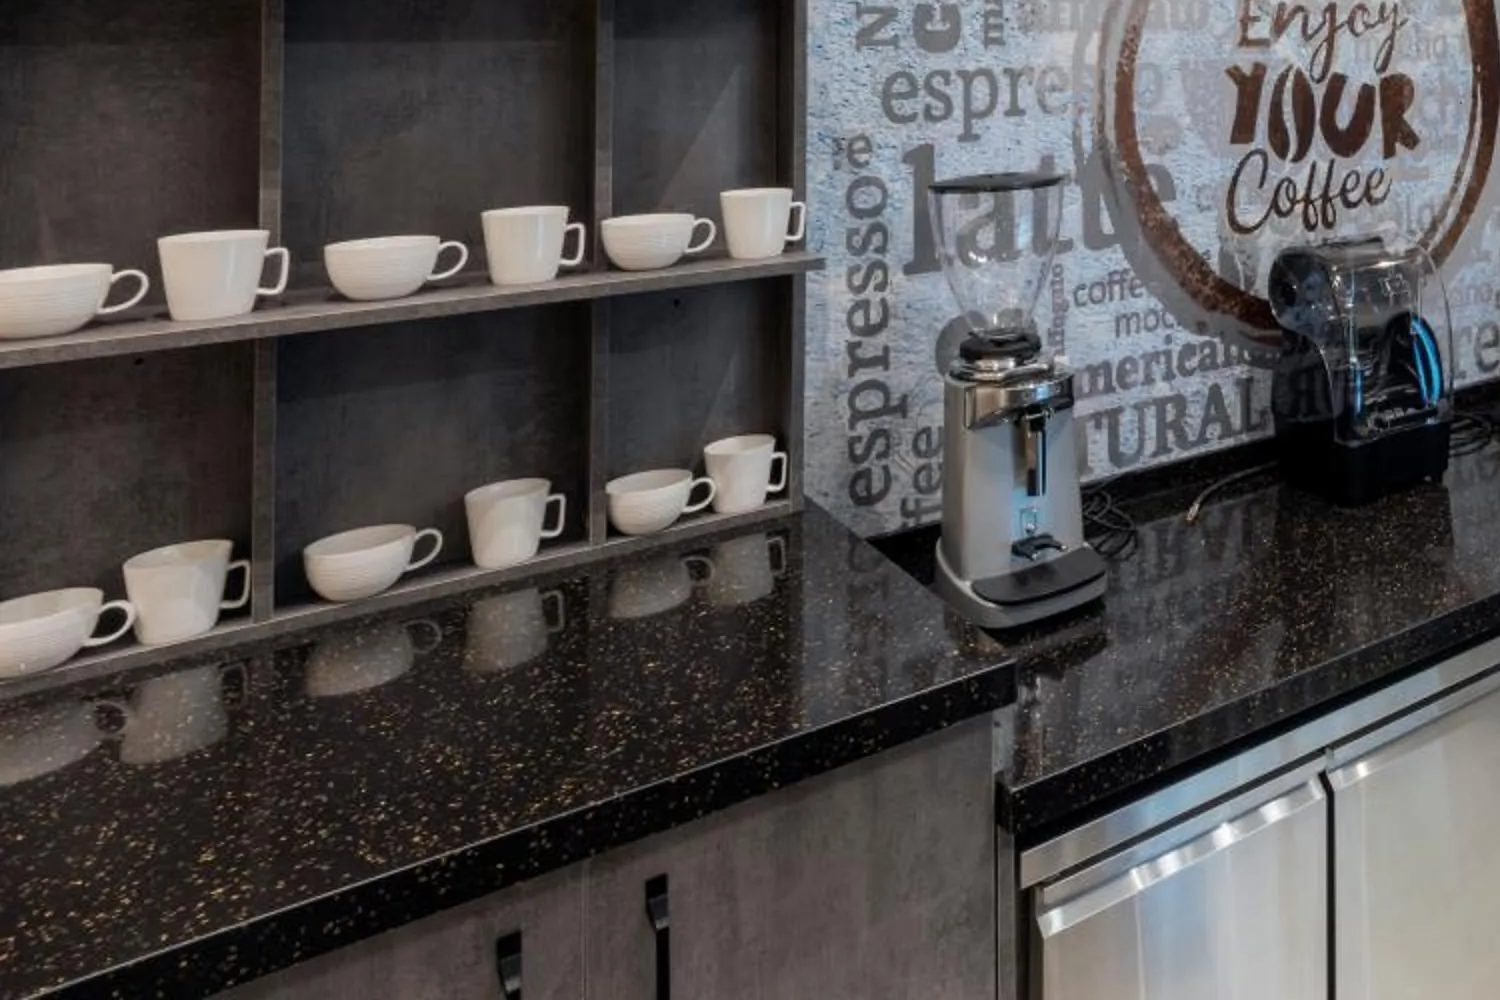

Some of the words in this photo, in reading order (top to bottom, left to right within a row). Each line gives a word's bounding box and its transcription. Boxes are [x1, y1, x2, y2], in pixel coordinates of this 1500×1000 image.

[1223, 61, 1421, 164] YOUR
[1225, 147, 1394, 236] Coffee
[845, 173, 908, 508] espresso
[1080, 376, 1266, 474] TURAL
